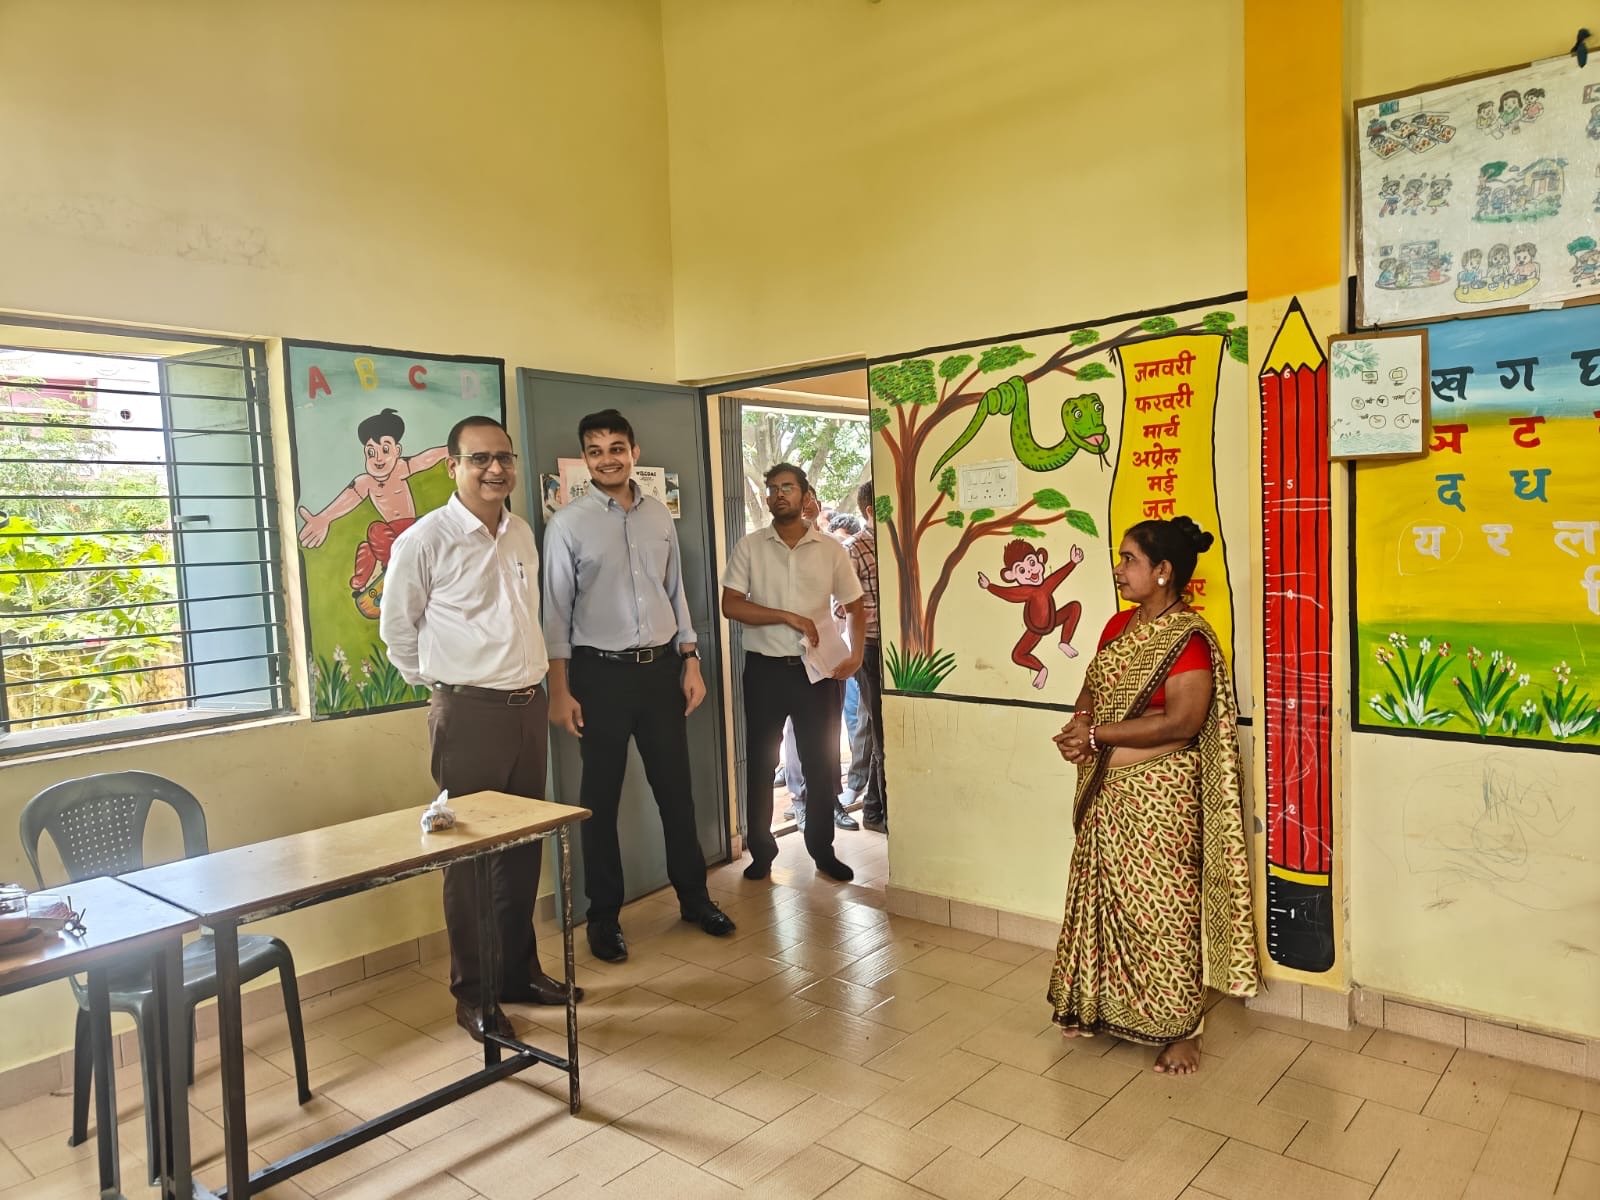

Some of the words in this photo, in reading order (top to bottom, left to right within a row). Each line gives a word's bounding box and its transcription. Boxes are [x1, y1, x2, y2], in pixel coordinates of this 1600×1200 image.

[308, 365, 332, 400] A
[353, 357, 379, 392] B
[408, 365, 428, 391] C
[461, 368, 481, 401] D
[1134, 350, 1196, 383] जनवरी
[1283, 368, 1291, 380] 6
[1431, 366, 1474, 402] ख
[1496, 357, 1539, 391] ग
[1134, 382, 1194, 414] फरवरी
[1143, 415, 1180, 439] मार्च
[1509, 416, 1546, 448] ट
[1147, 468, 1178, 496] मई
[1286, 480, 1294, 489] 5
[1435, 473, 1466, 512] द
[1509, 468, 1552, 502] ध
[1143, 498, 1176, 521] जून
[1412, 526, 1445, 560] य
[1481, 523, 1513, 557] र
[1552, 521, 1600, 558] ल
[1286, 589, 1294, 600] 4
[1287, 698, 1295, 709] 3
[1288, 804, 1296, 815] 2
[1289, 908, 1295, 919] 1
